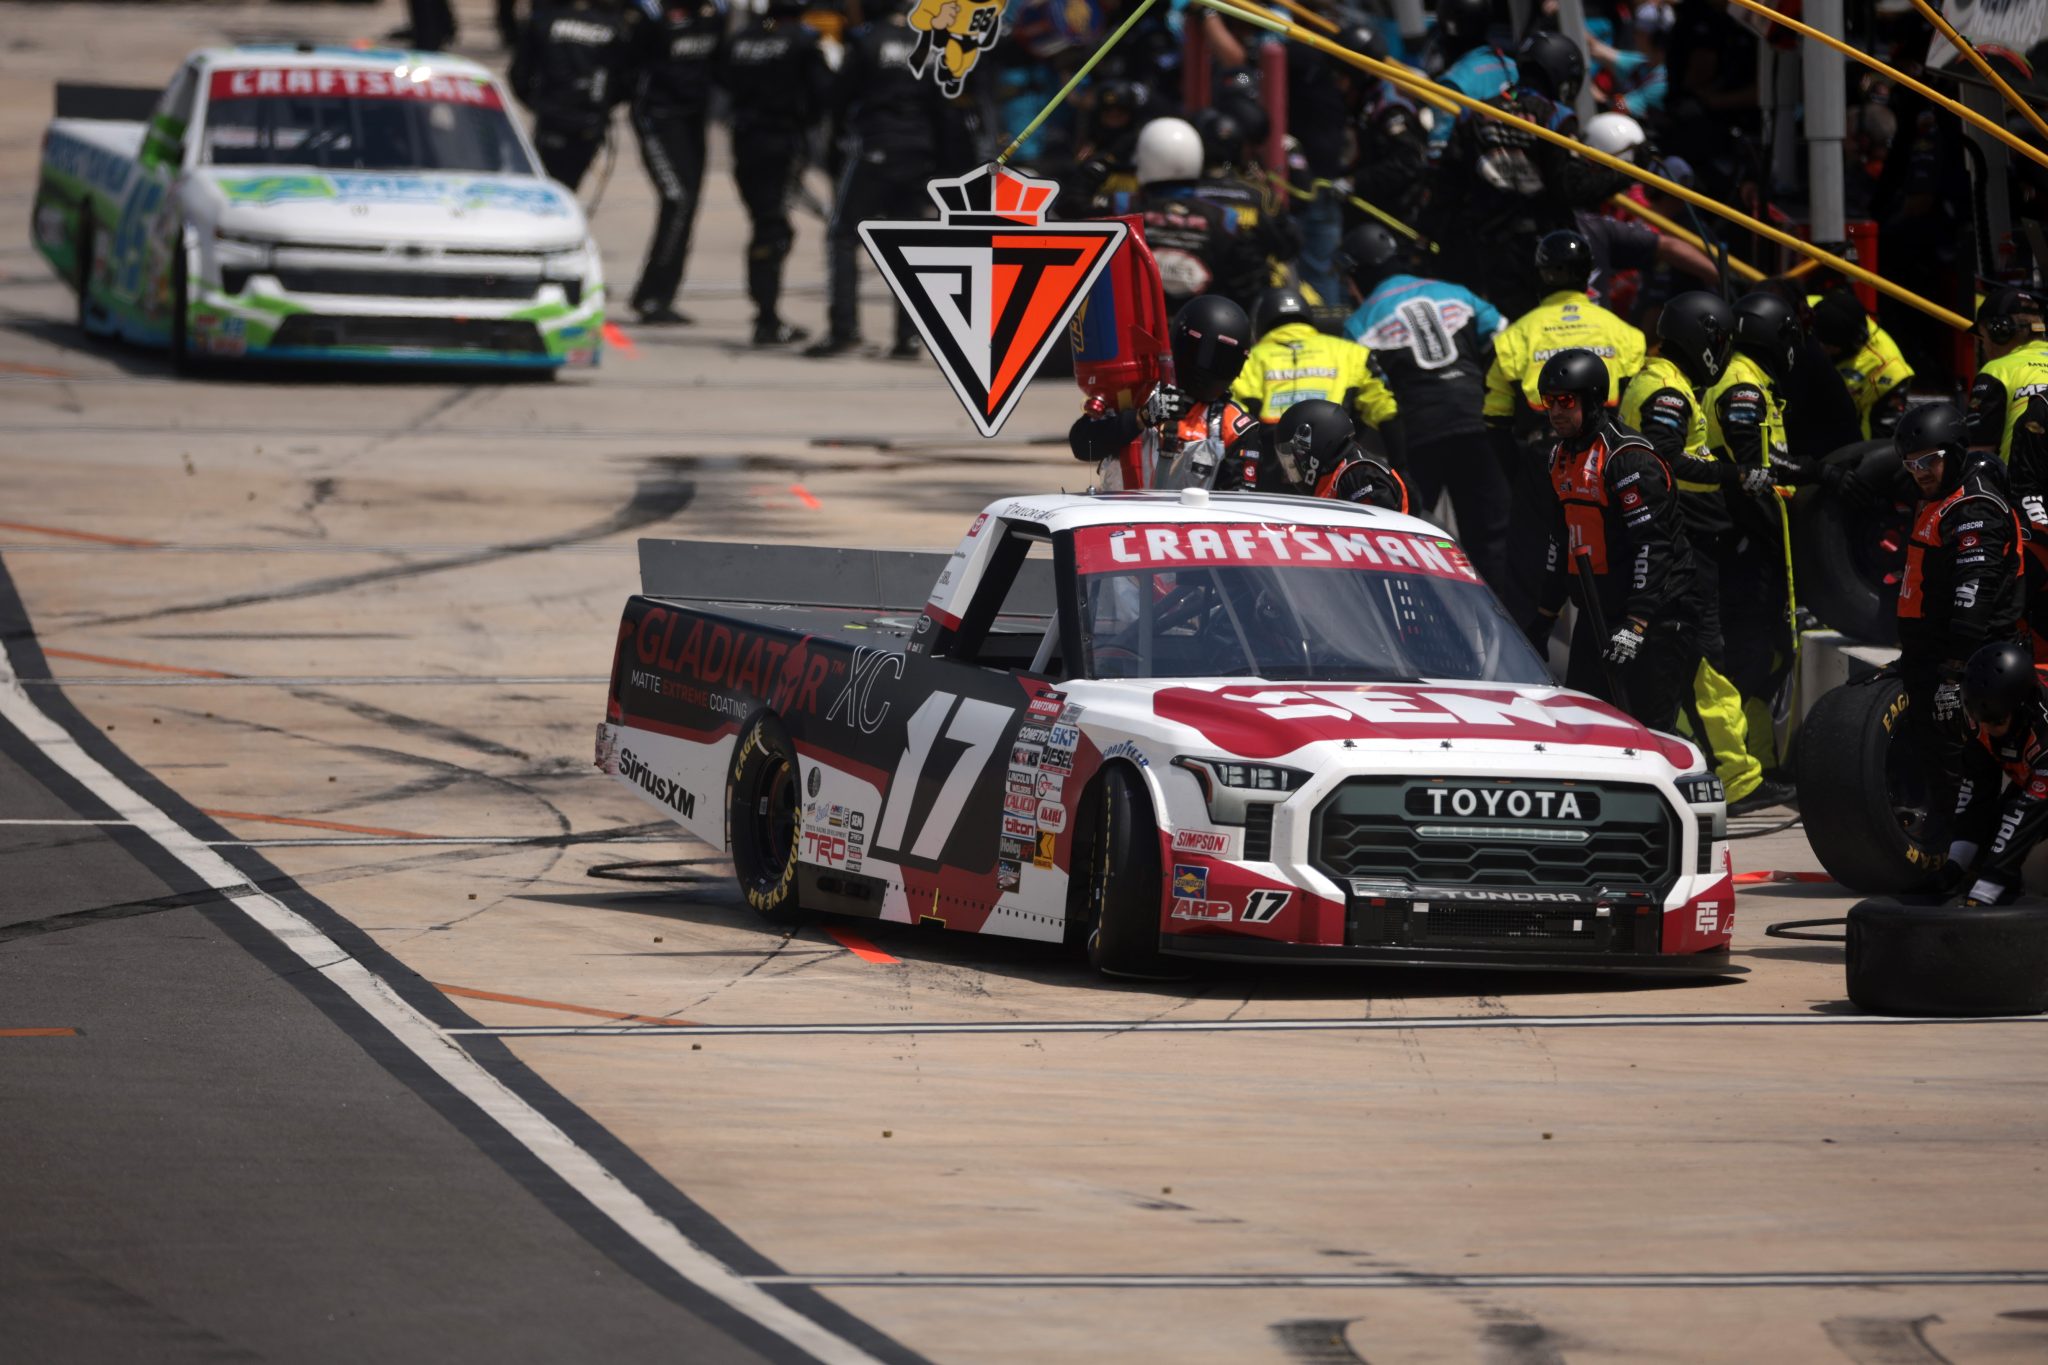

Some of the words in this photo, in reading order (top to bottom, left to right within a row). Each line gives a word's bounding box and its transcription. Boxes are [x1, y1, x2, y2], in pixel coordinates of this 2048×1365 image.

[969, 7, 996, 32] 88
[231, 68, 485, 103] CRAFTSMAN
[1109, 528, 1456, 574] CRAFTSMAN
[636, 607, 828, 717] GLADIATOR
[631, 669, 662, 694] MATTE
[662, 680, 708, 708] EXTREME
[709, 693, 748, 720] COATING
[826, 645, 906, 734] XC
[1030, 699, 1061, 713] CRAFTSMAN
[1221, 685, 1640, 730] SEM
[1018, 727, 1050, 742] COMETIC
[1049, 727, 1079, 747] SKF
[734, 722, 763, 781] EAGLE
[1041, 745, 1074, 769] JESEL
[1102, 740, 1149, 768] GOODYEAR
[618, 748, 696, 820] SiriusXM
[876, 690, 1016, 861] 17
[1005, 794, 1035, 813] CALICO
[1427, 788, 1582, 819] TOYOTA
[1004, 817, 1034, 836] tilton
[804, 832, 846, 865] TRD
[1000, 837, 1021, 859] Holley
[1176, 831, 1226, 852] SIMPSON
[748, 806, 801, 911] GOODYEAR
[1176, 878, 1204, 889] SUNOCO
[1439, 890, 1582, 902] TUNDRA
[1173, 901, 1232, 918] ARP
[1242, 891, 1291, 921] 17
